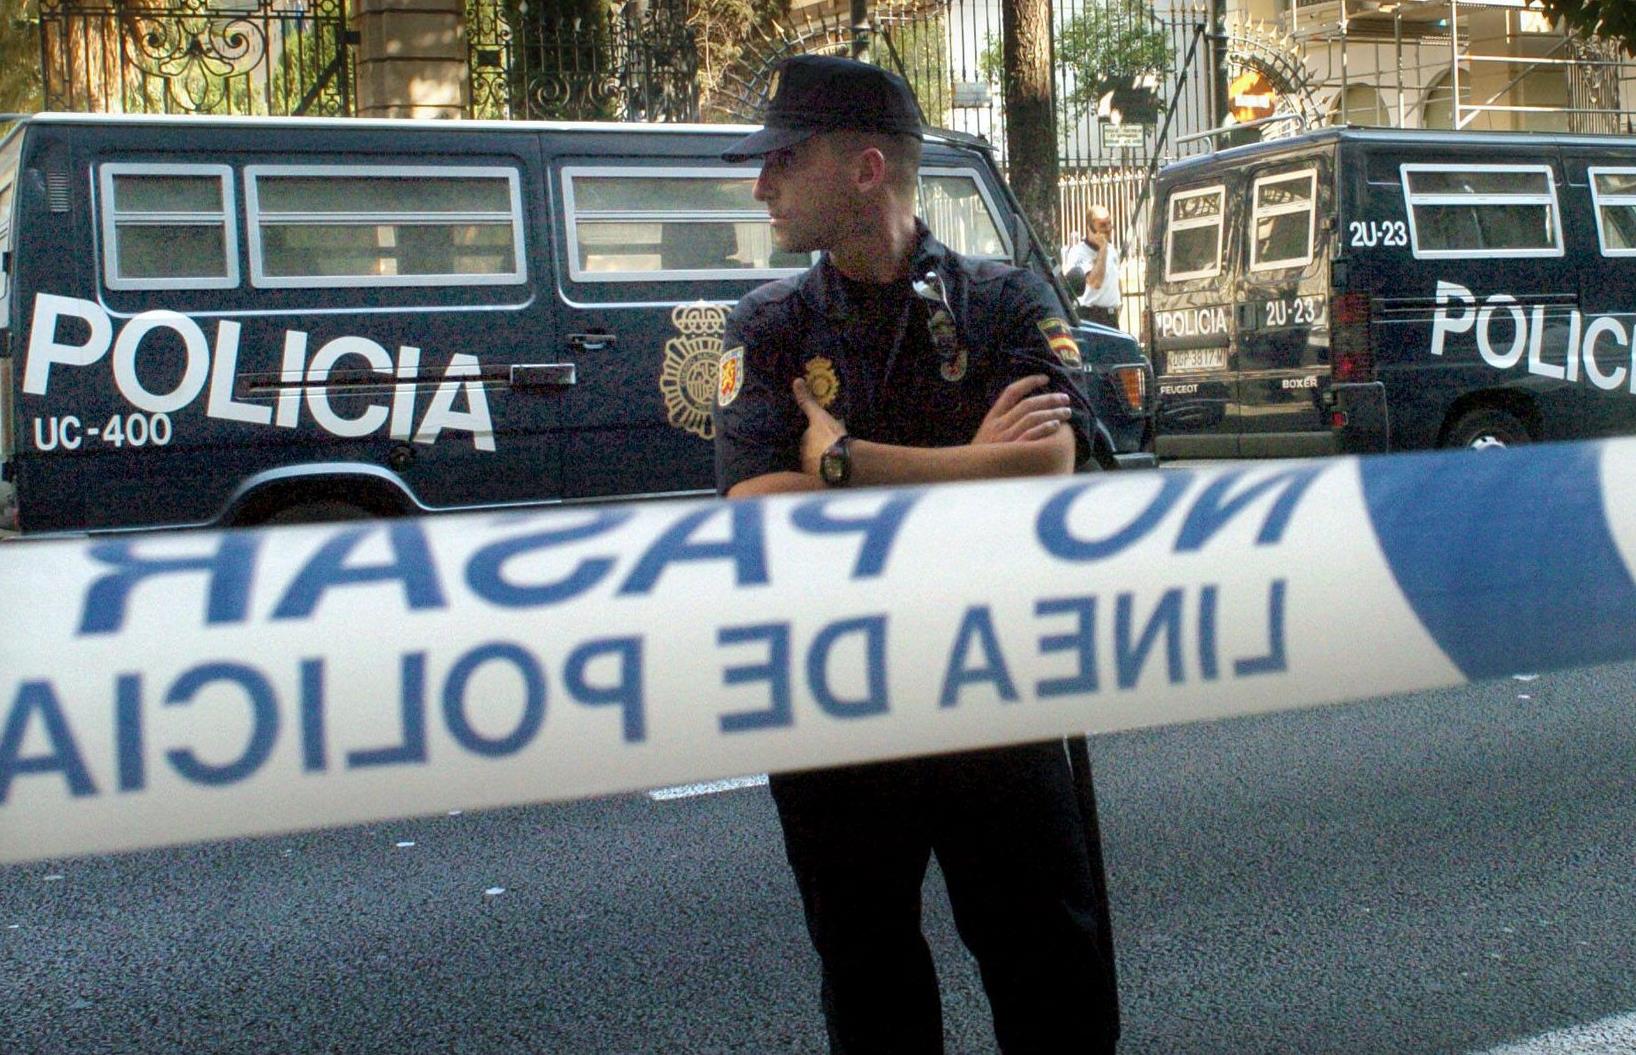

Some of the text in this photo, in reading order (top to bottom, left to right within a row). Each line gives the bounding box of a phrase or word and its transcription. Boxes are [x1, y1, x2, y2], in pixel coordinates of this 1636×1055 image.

[1349, 220, 1408, 247] 2U-23
[1162, 307, 1228, 337] POLICIA
[1266, 297, 1316, 326] 2U-23
[23, 292, 496, 452] POLICIA
[1281, 377, 1318, 389] BOXER
[34, 412, 172, 451] UC-400
